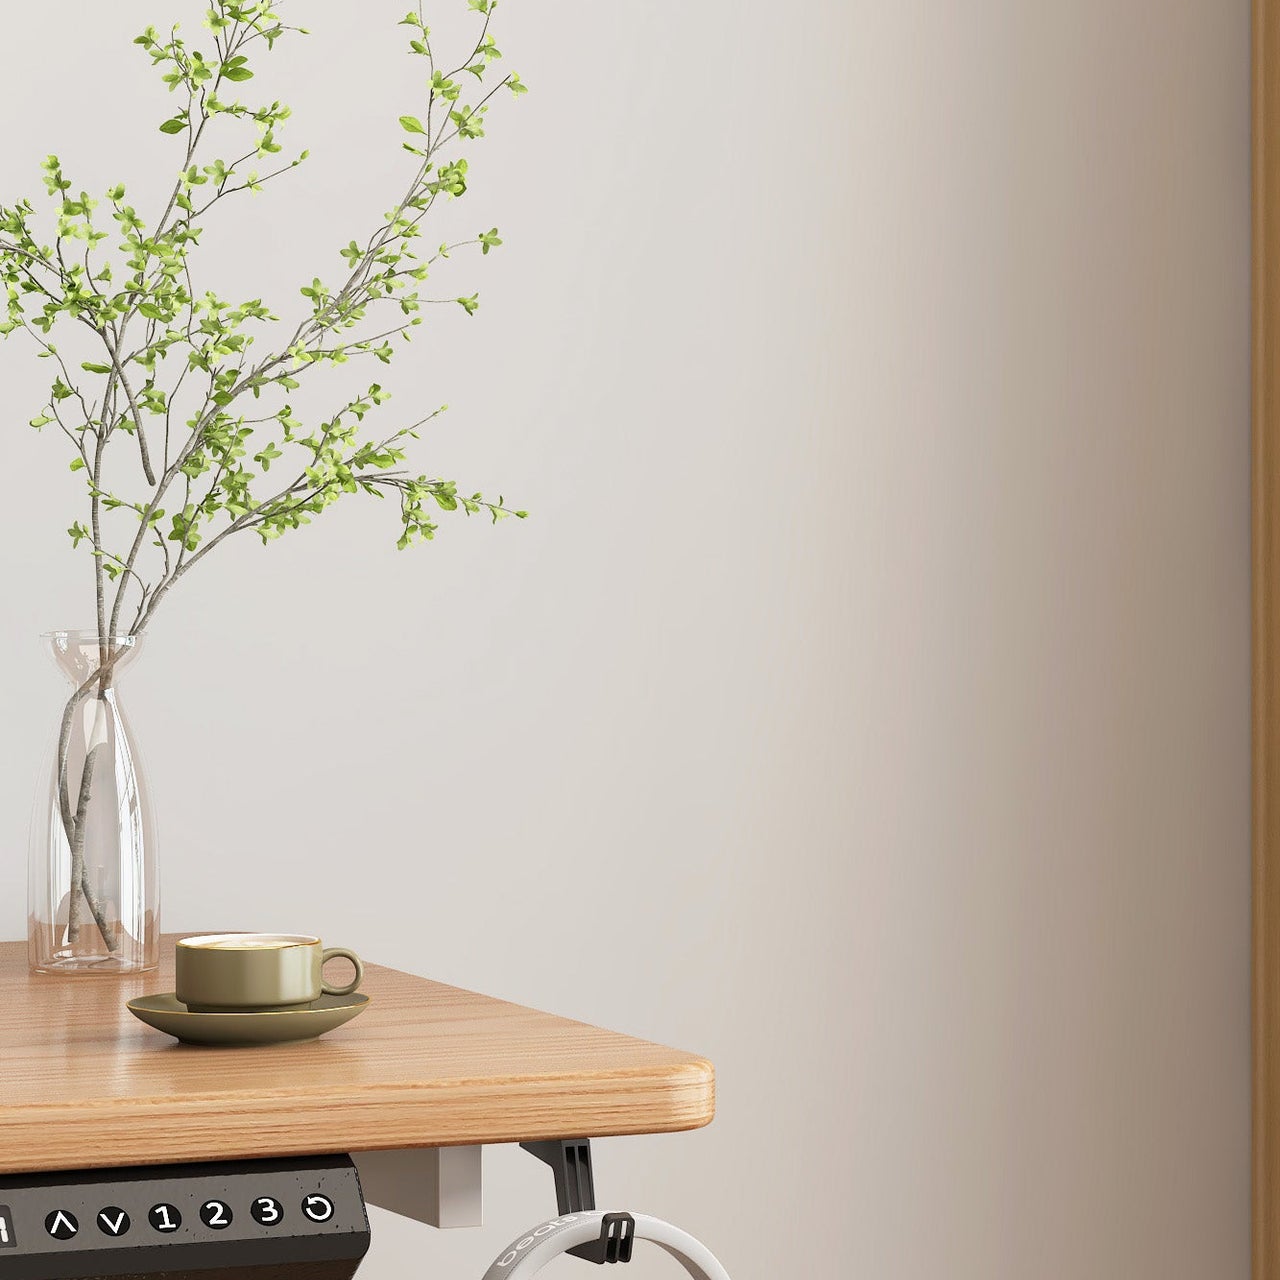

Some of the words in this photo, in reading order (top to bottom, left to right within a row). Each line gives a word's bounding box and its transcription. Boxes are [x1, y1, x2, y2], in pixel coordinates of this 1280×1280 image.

[155, 1206, 177, 1229] 1
[206, 1202, 228, 1225] 2
[256, 1198, 278, 1222] 3
